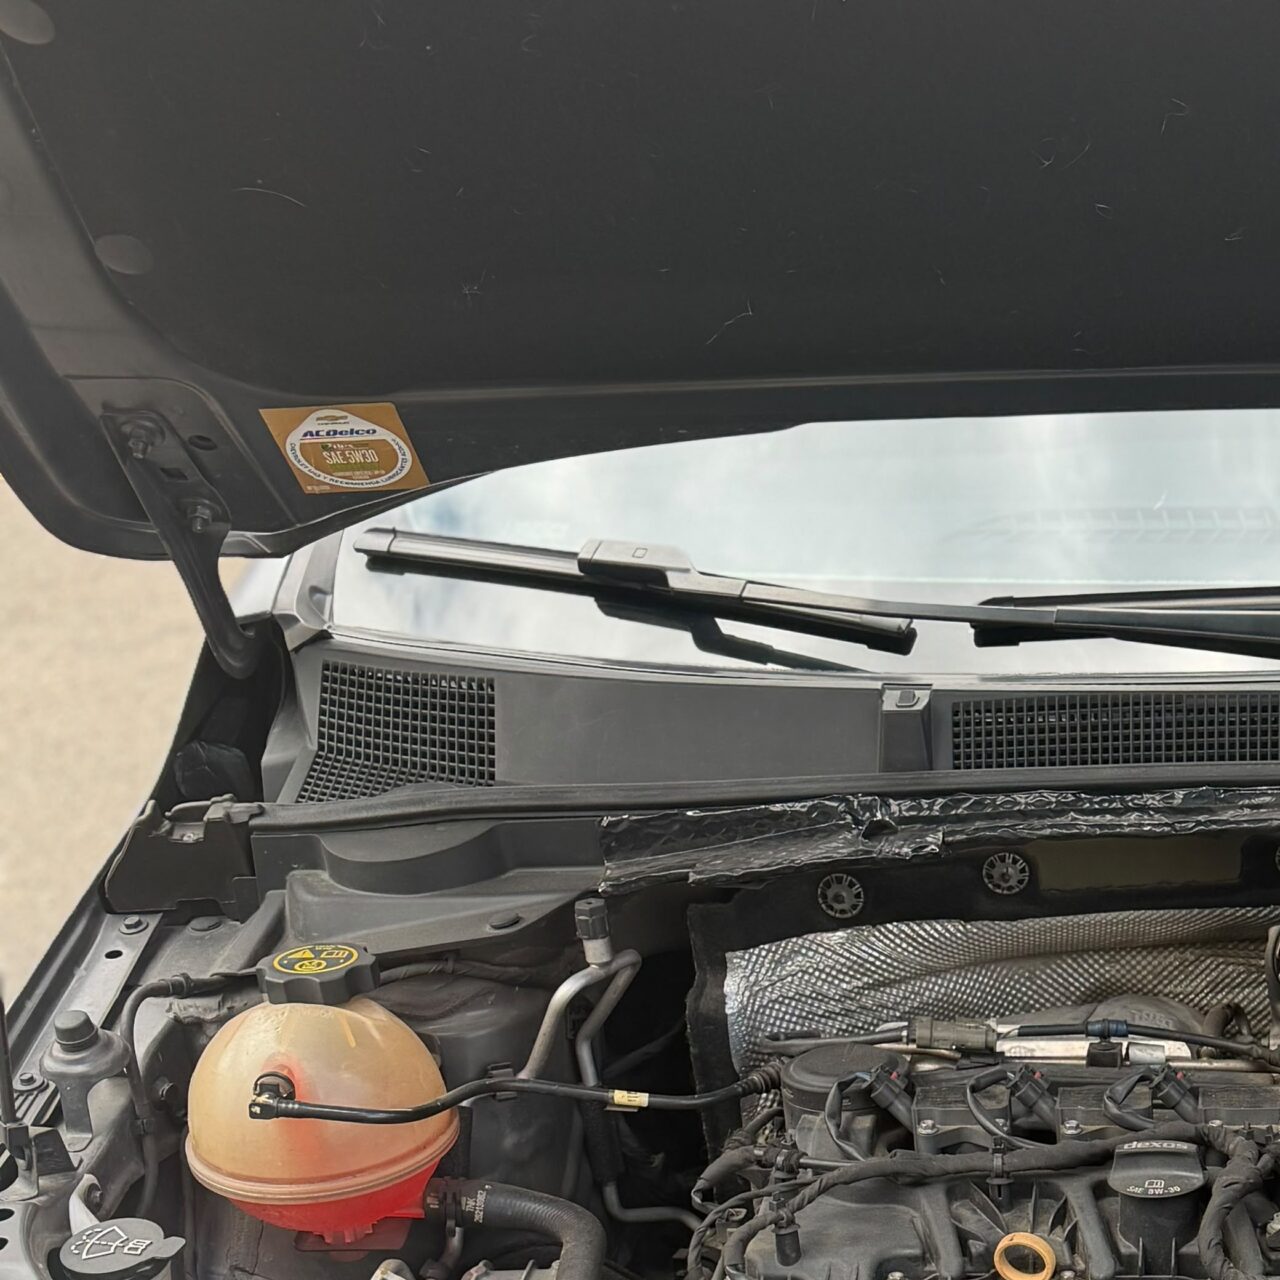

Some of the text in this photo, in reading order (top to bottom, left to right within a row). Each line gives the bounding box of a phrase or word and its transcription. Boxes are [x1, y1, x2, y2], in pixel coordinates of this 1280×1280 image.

[302, 428, 378, 438] ACDelco
[322, 449, 379, 465] SAE 5W30
[1123, 1141, 1188, 1150] dexos
